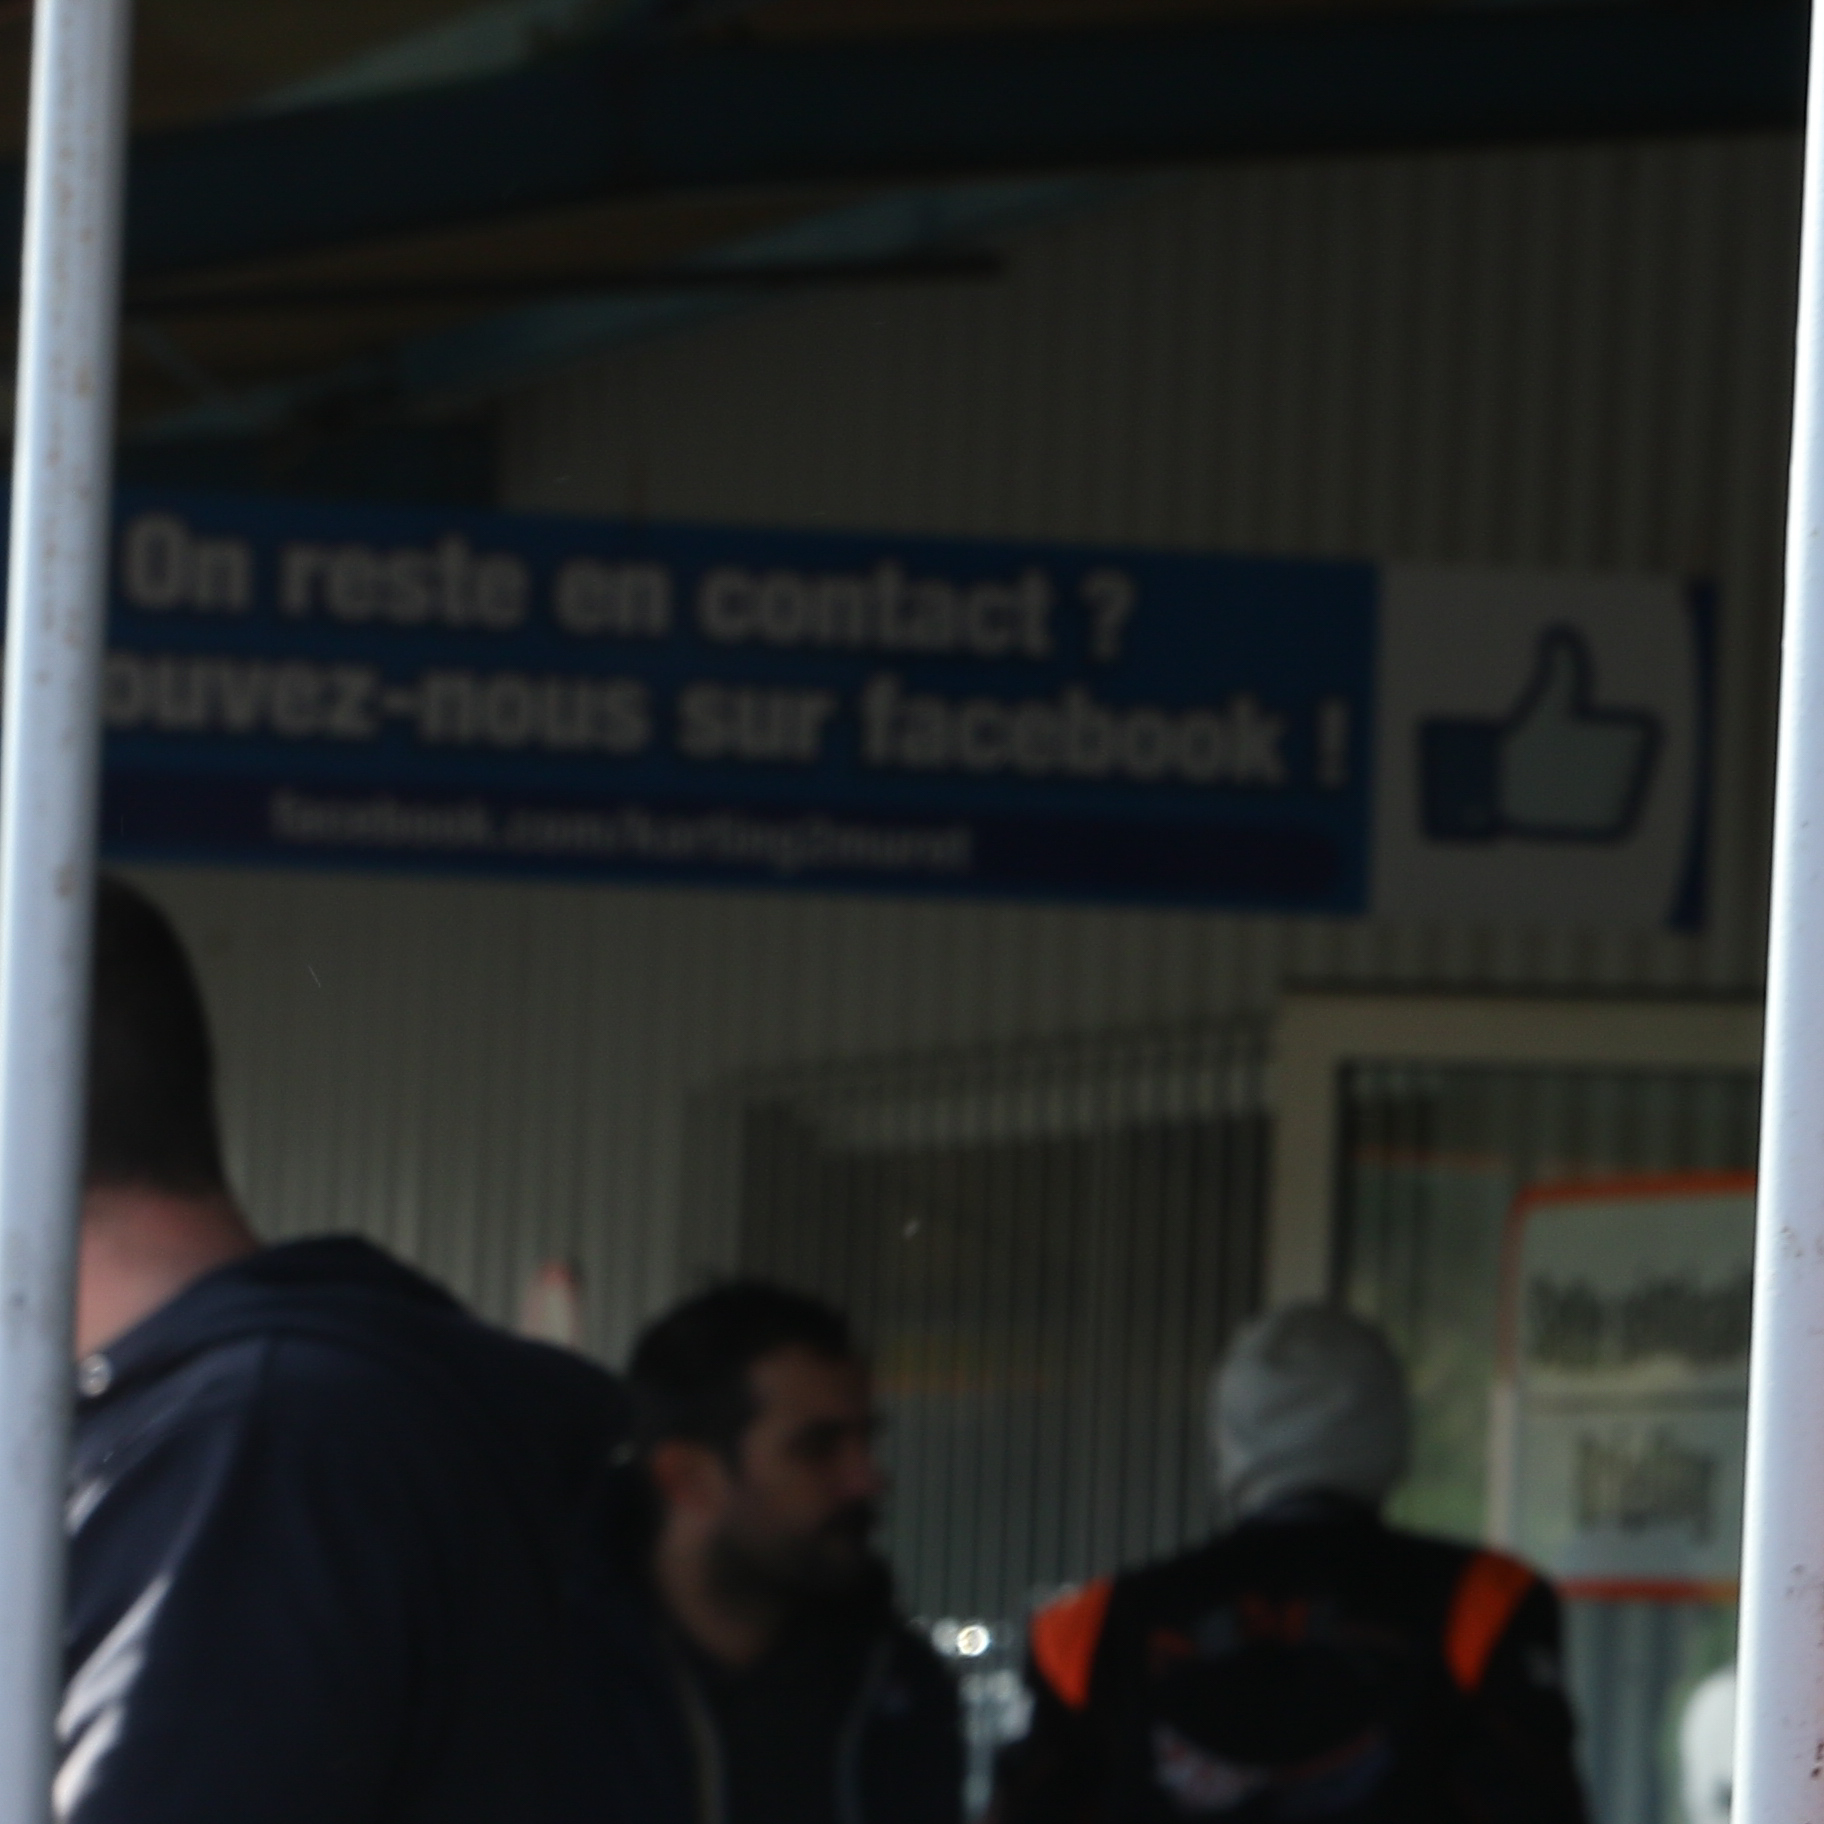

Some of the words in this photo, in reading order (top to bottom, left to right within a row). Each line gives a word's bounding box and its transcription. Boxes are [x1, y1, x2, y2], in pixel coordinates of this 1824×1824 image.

[126, 515, 252, 611] On
[279, 532, 529, 628] reste
[553, 552, 672, 637] en
[697, 558, 1054, 658] contact
[1083, 572, 1135, 662] ?
[675, 680, 834, 762] sur
[858, 675, 1287, 788] facebook
[1318, 698, 1350, 788] !
